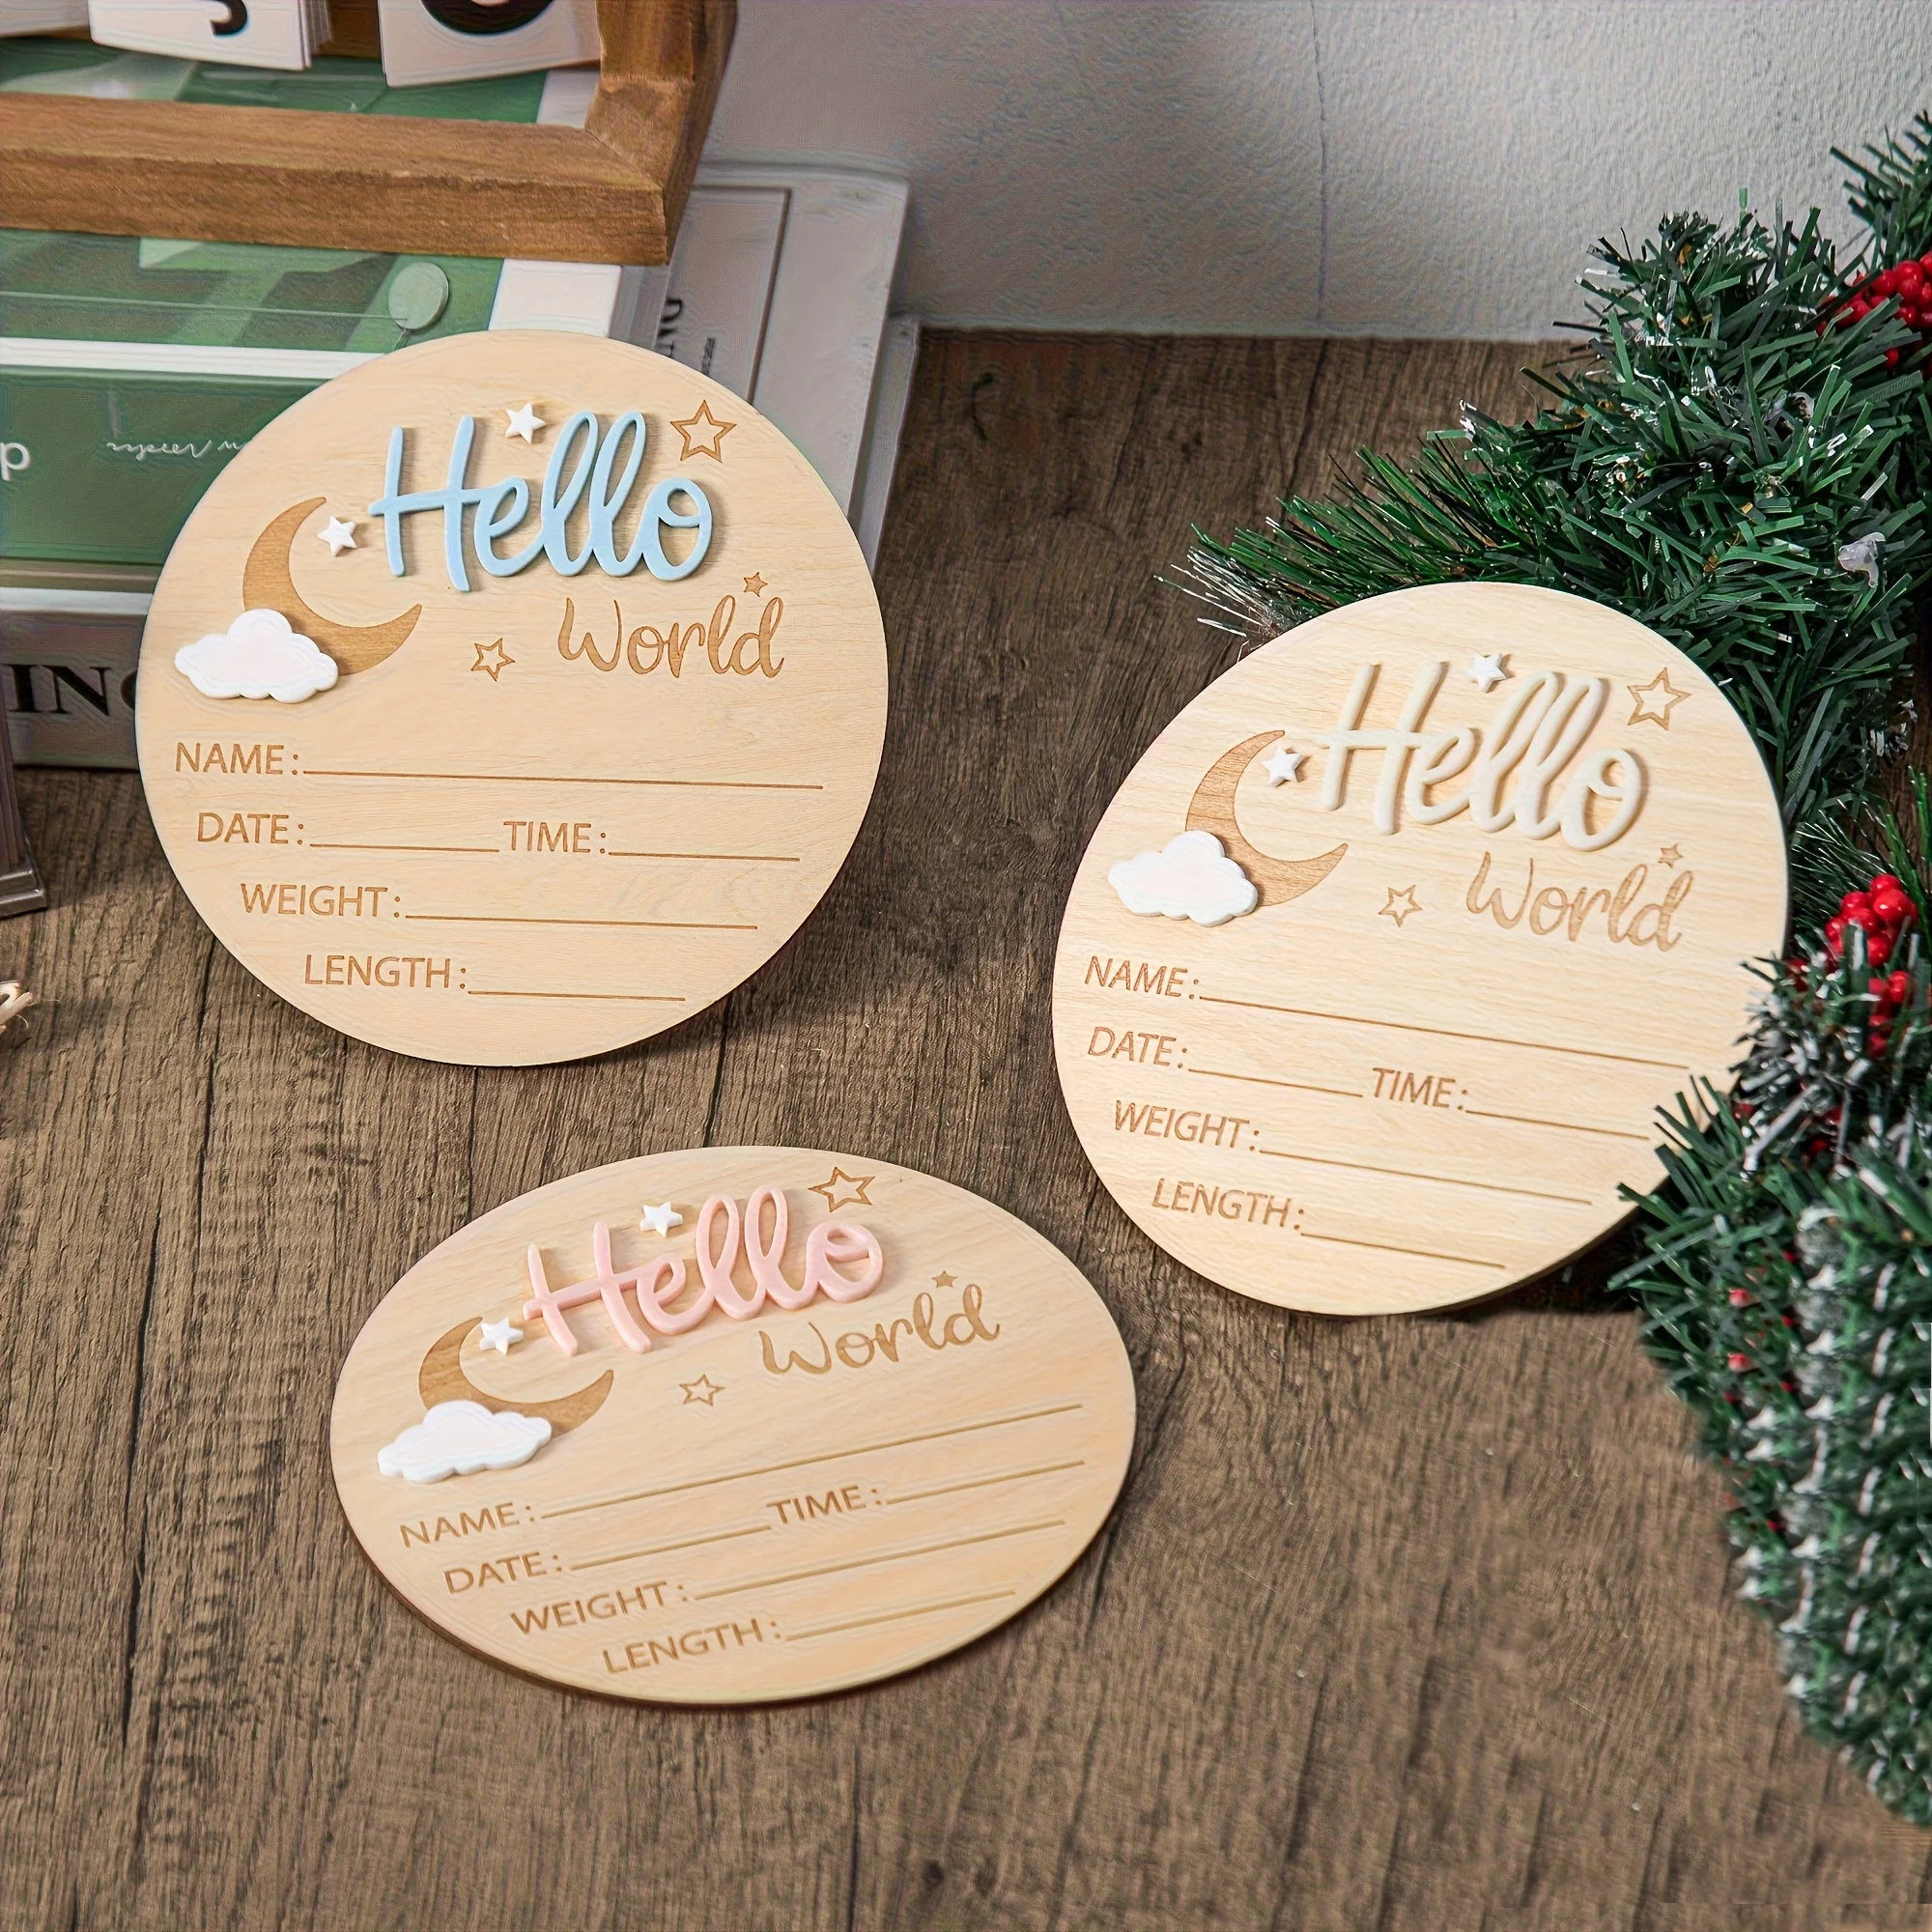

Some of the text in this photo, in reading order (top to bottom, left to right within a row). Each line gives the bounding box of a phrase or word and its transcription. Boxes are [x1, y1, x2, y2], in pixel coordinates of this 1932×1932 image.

[368, 411, 713, 592] Hello
[557, 594, 784, 678] World
[175, 742, 298, 775] NAME:
[1316, 661, 1643, 852] Hello
[197, 811, 606, 854] DATE: TIME:
[241, 883, 401, 918] WEIGHT:
[1466, 851, 1693, 952] World
[304, 954, 467, 989] LENGTH:
[1084, 955, 1200, 1000] NAME:
[1088, 1026, 1468, 1111] DATE: TIME:
[1114, 1100, 1260, 1151] WEIGHT:
[1151, 1178, 1304, 1231] LENGTH:
[523, 1185, 883, 1356] Hello
[758, 1283, 1000, 1375] World
[399, 1502, 537, 1548] NAME:
[443, 1485, 882, 1594] DATE: TIME:
[510, 1580, 689, 1635] WEIGHT:
[602, 1618, 782, 1674] LENGTH:
